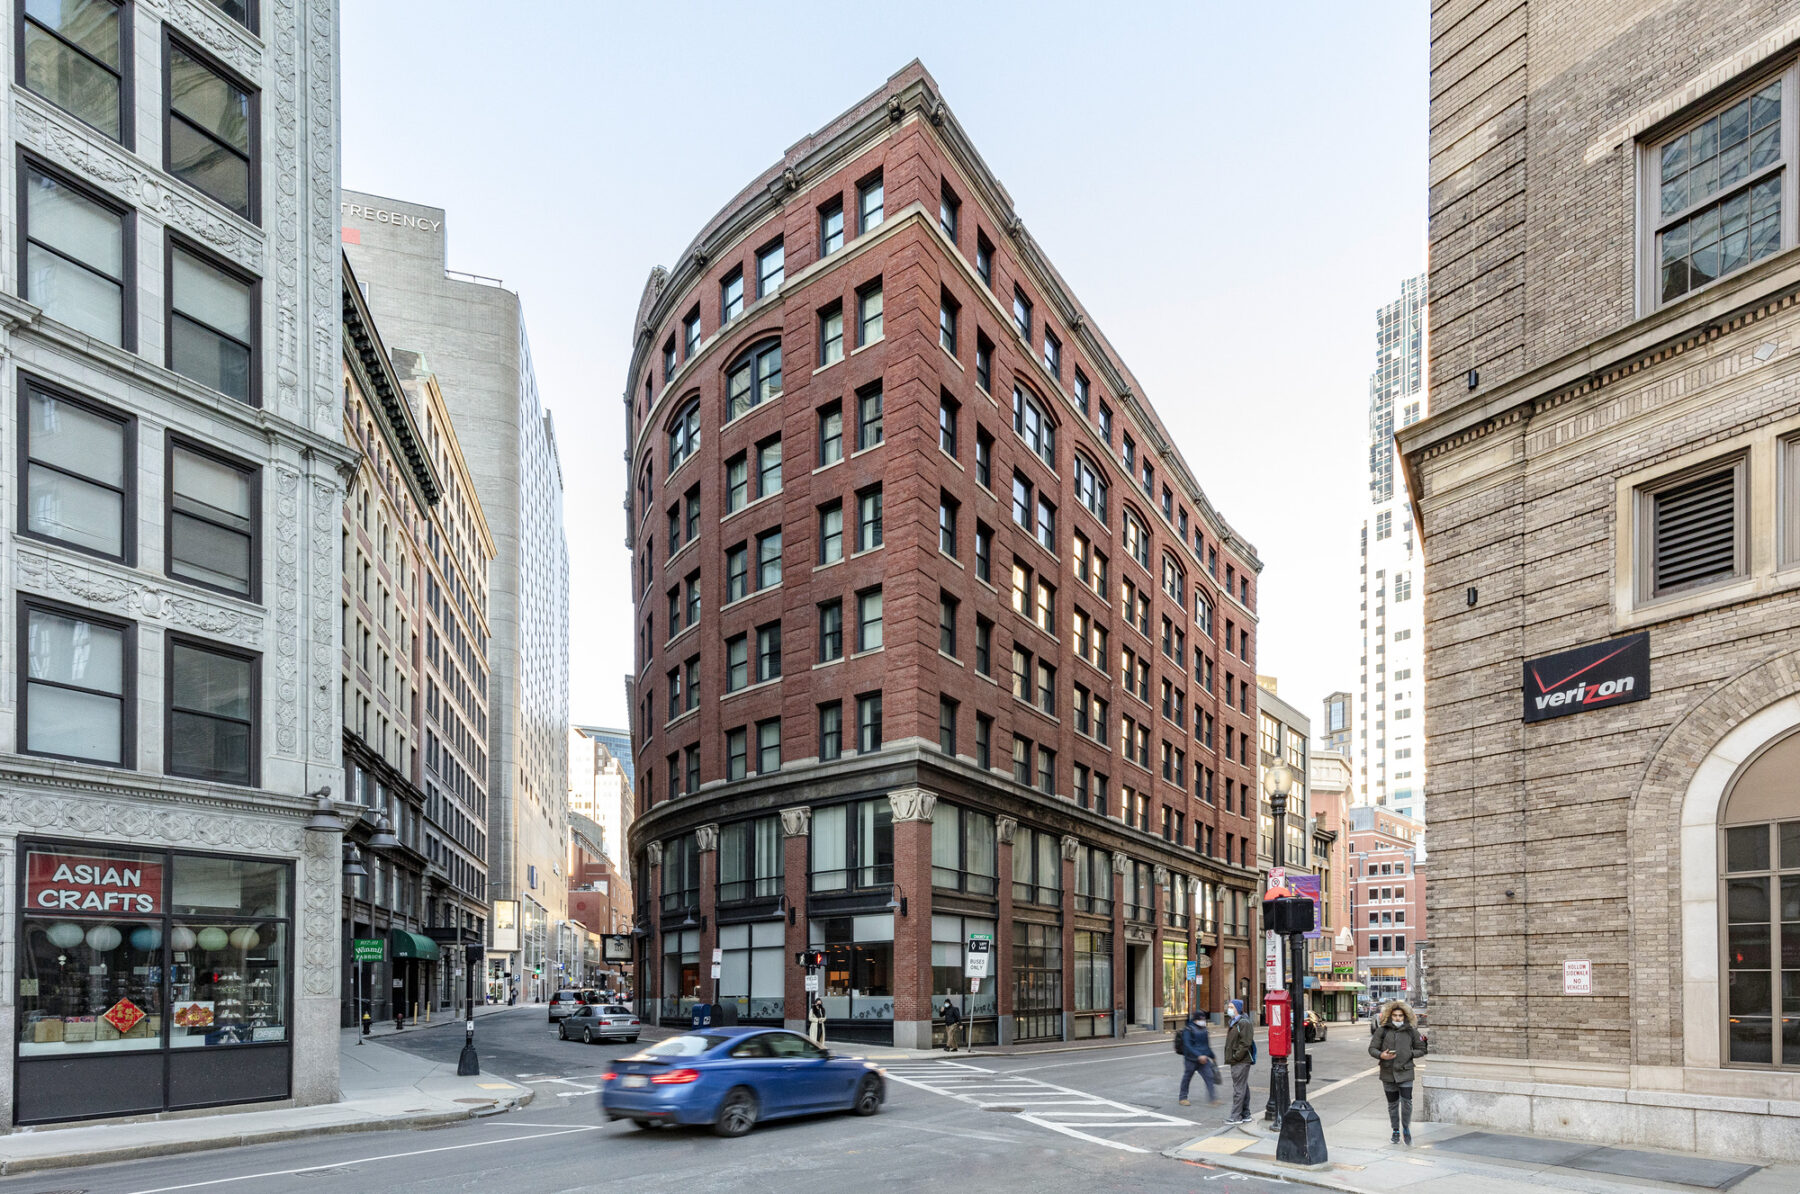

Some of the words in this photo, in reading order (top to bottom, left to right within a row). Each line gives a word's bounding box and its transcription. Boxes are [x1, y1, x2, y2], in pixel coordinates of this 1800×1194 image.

[1535, 676, 1634, 710] verizon
[52, 863, 141, 887] ASIAN
[37, 889, 154, 913] CRAFTS
[255, 1030, 282, 1038] OPEN
